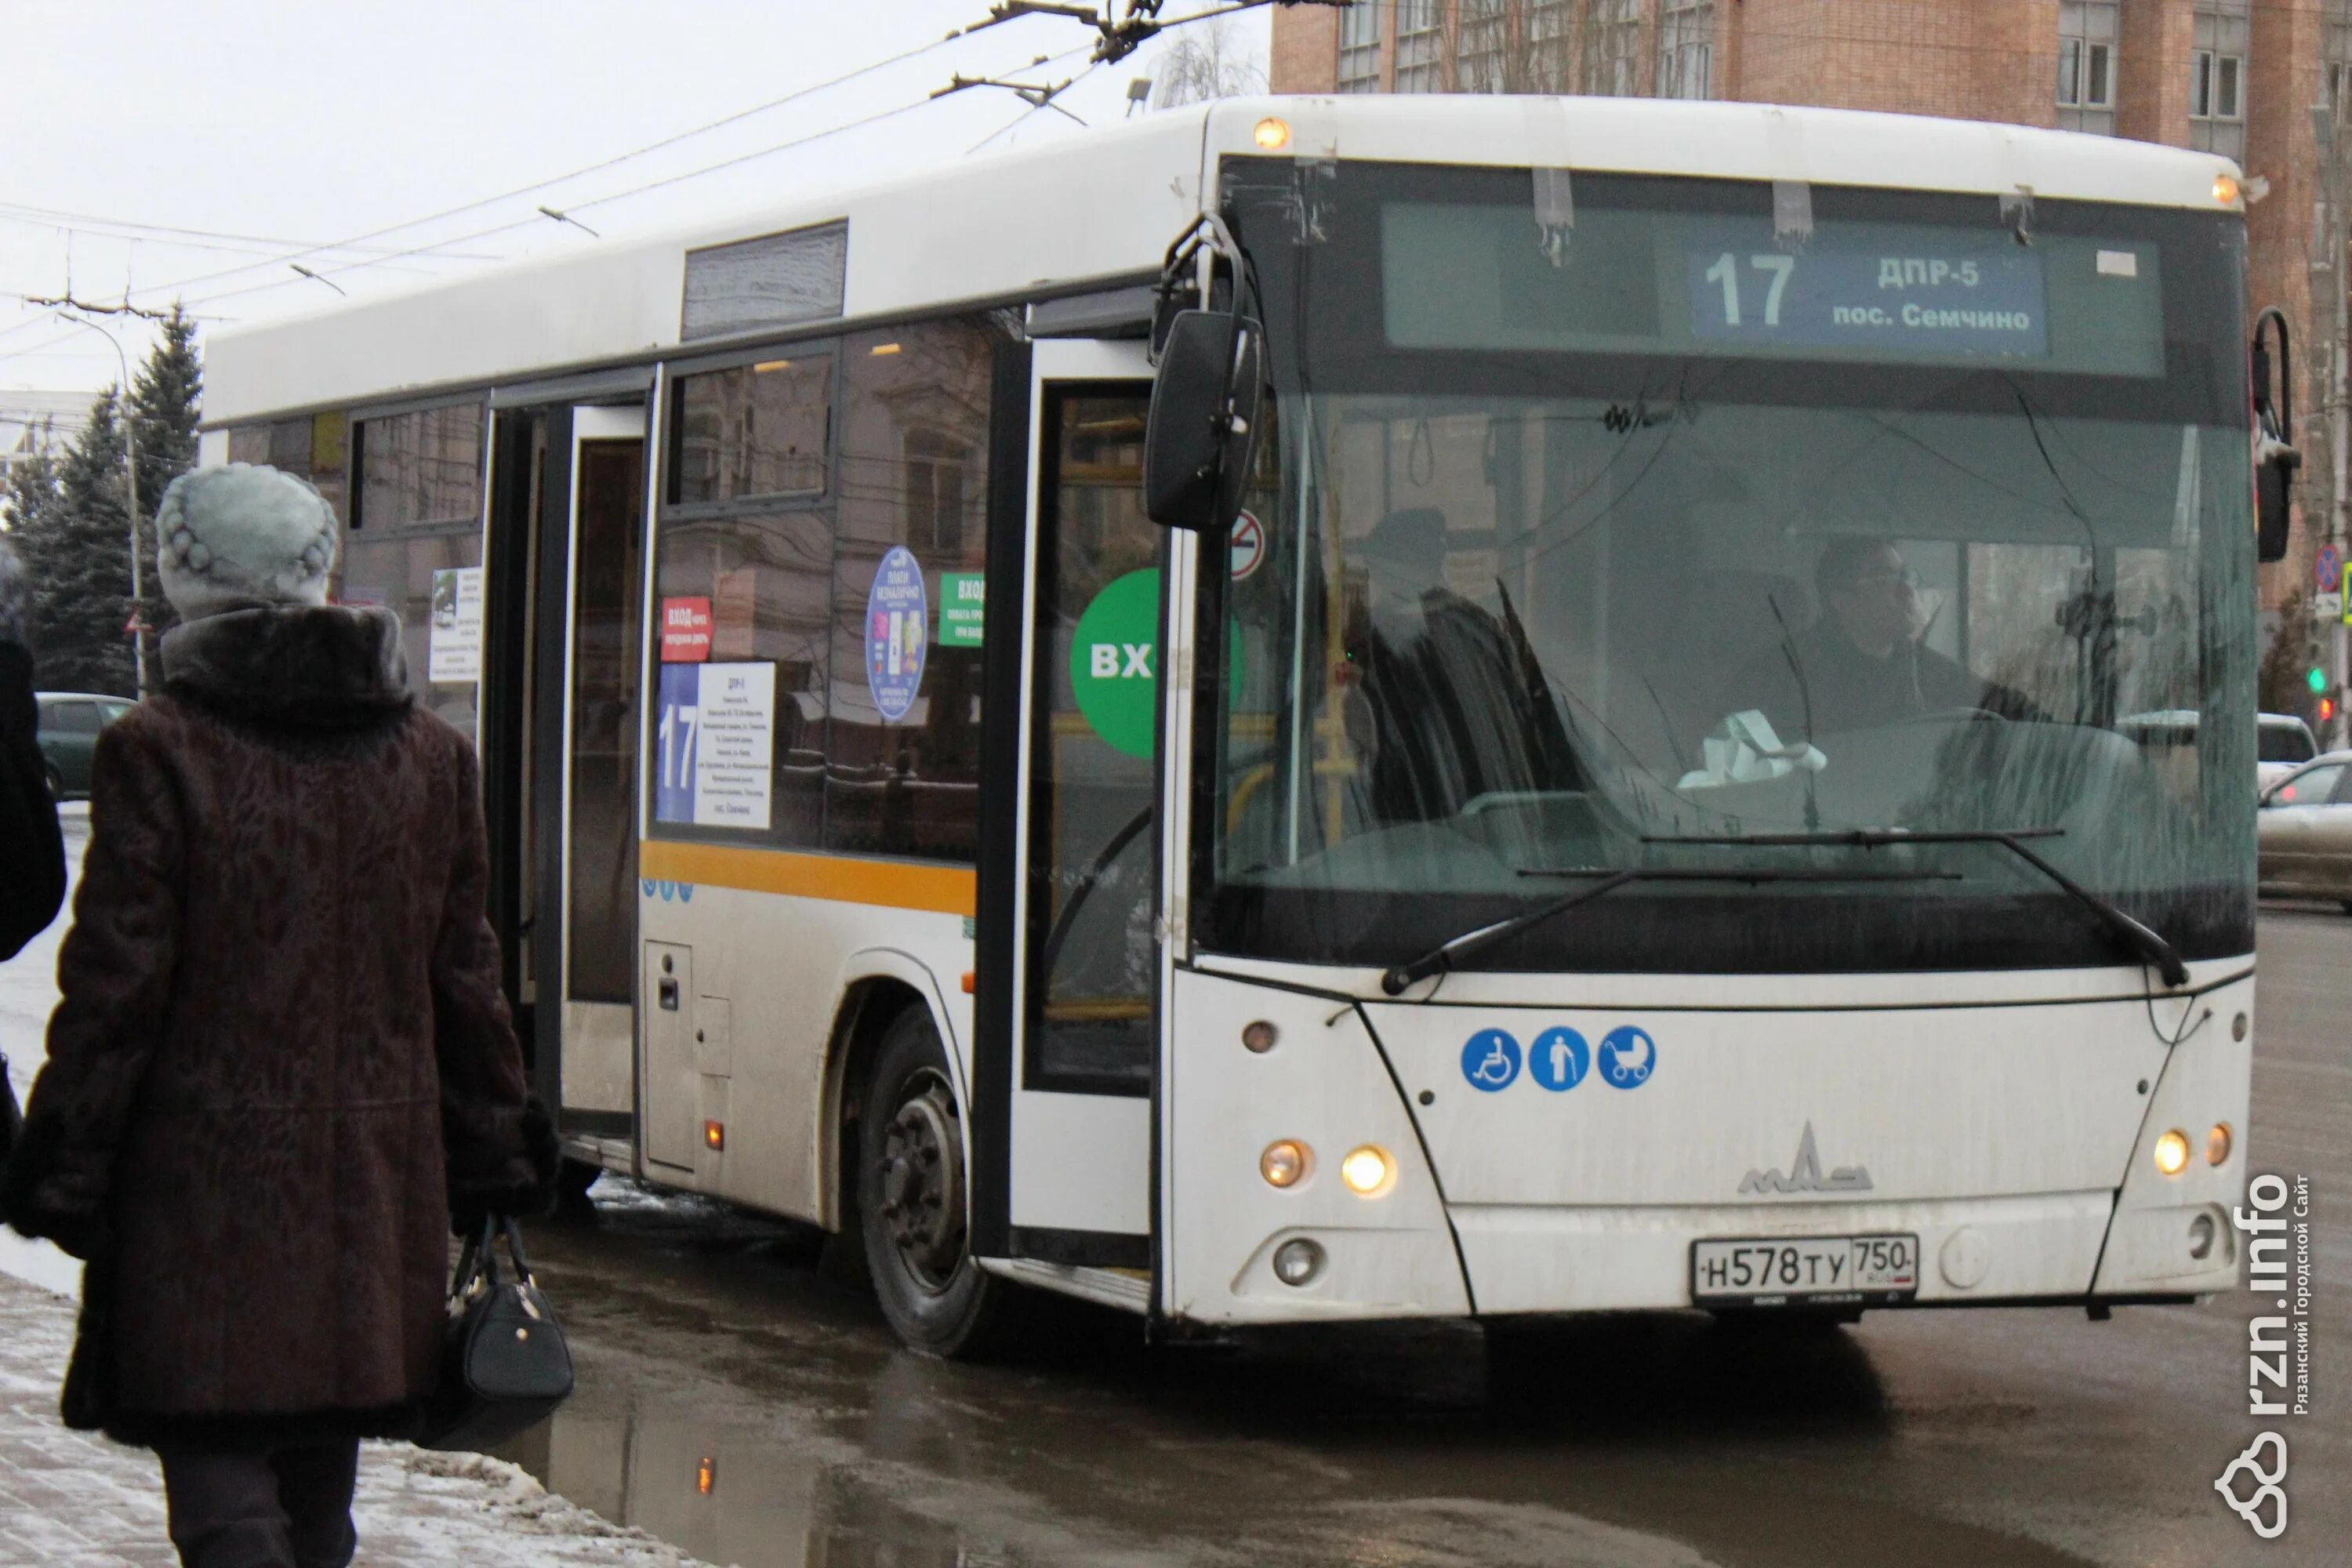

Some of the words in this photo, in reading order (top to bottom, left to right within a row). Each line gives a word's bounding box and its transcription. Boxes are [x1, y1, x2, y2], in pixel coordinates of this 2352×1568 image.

[1706, 252, 1795, 326] 17
[1878, 257, 1980, 289] ДПР-5
[1833, 304, 1893, 326] пос.
[1902, 303, 2030, 330] Семчино
[668, 608, 692, 628] ВХОД
[1091, 643, 1157, 678] ВХ
[659, 704, 697, 789] 17
[1708, 1247, 1845, 1287] Н578ТУ
[1854, 1241, 1906, 1272] 750
